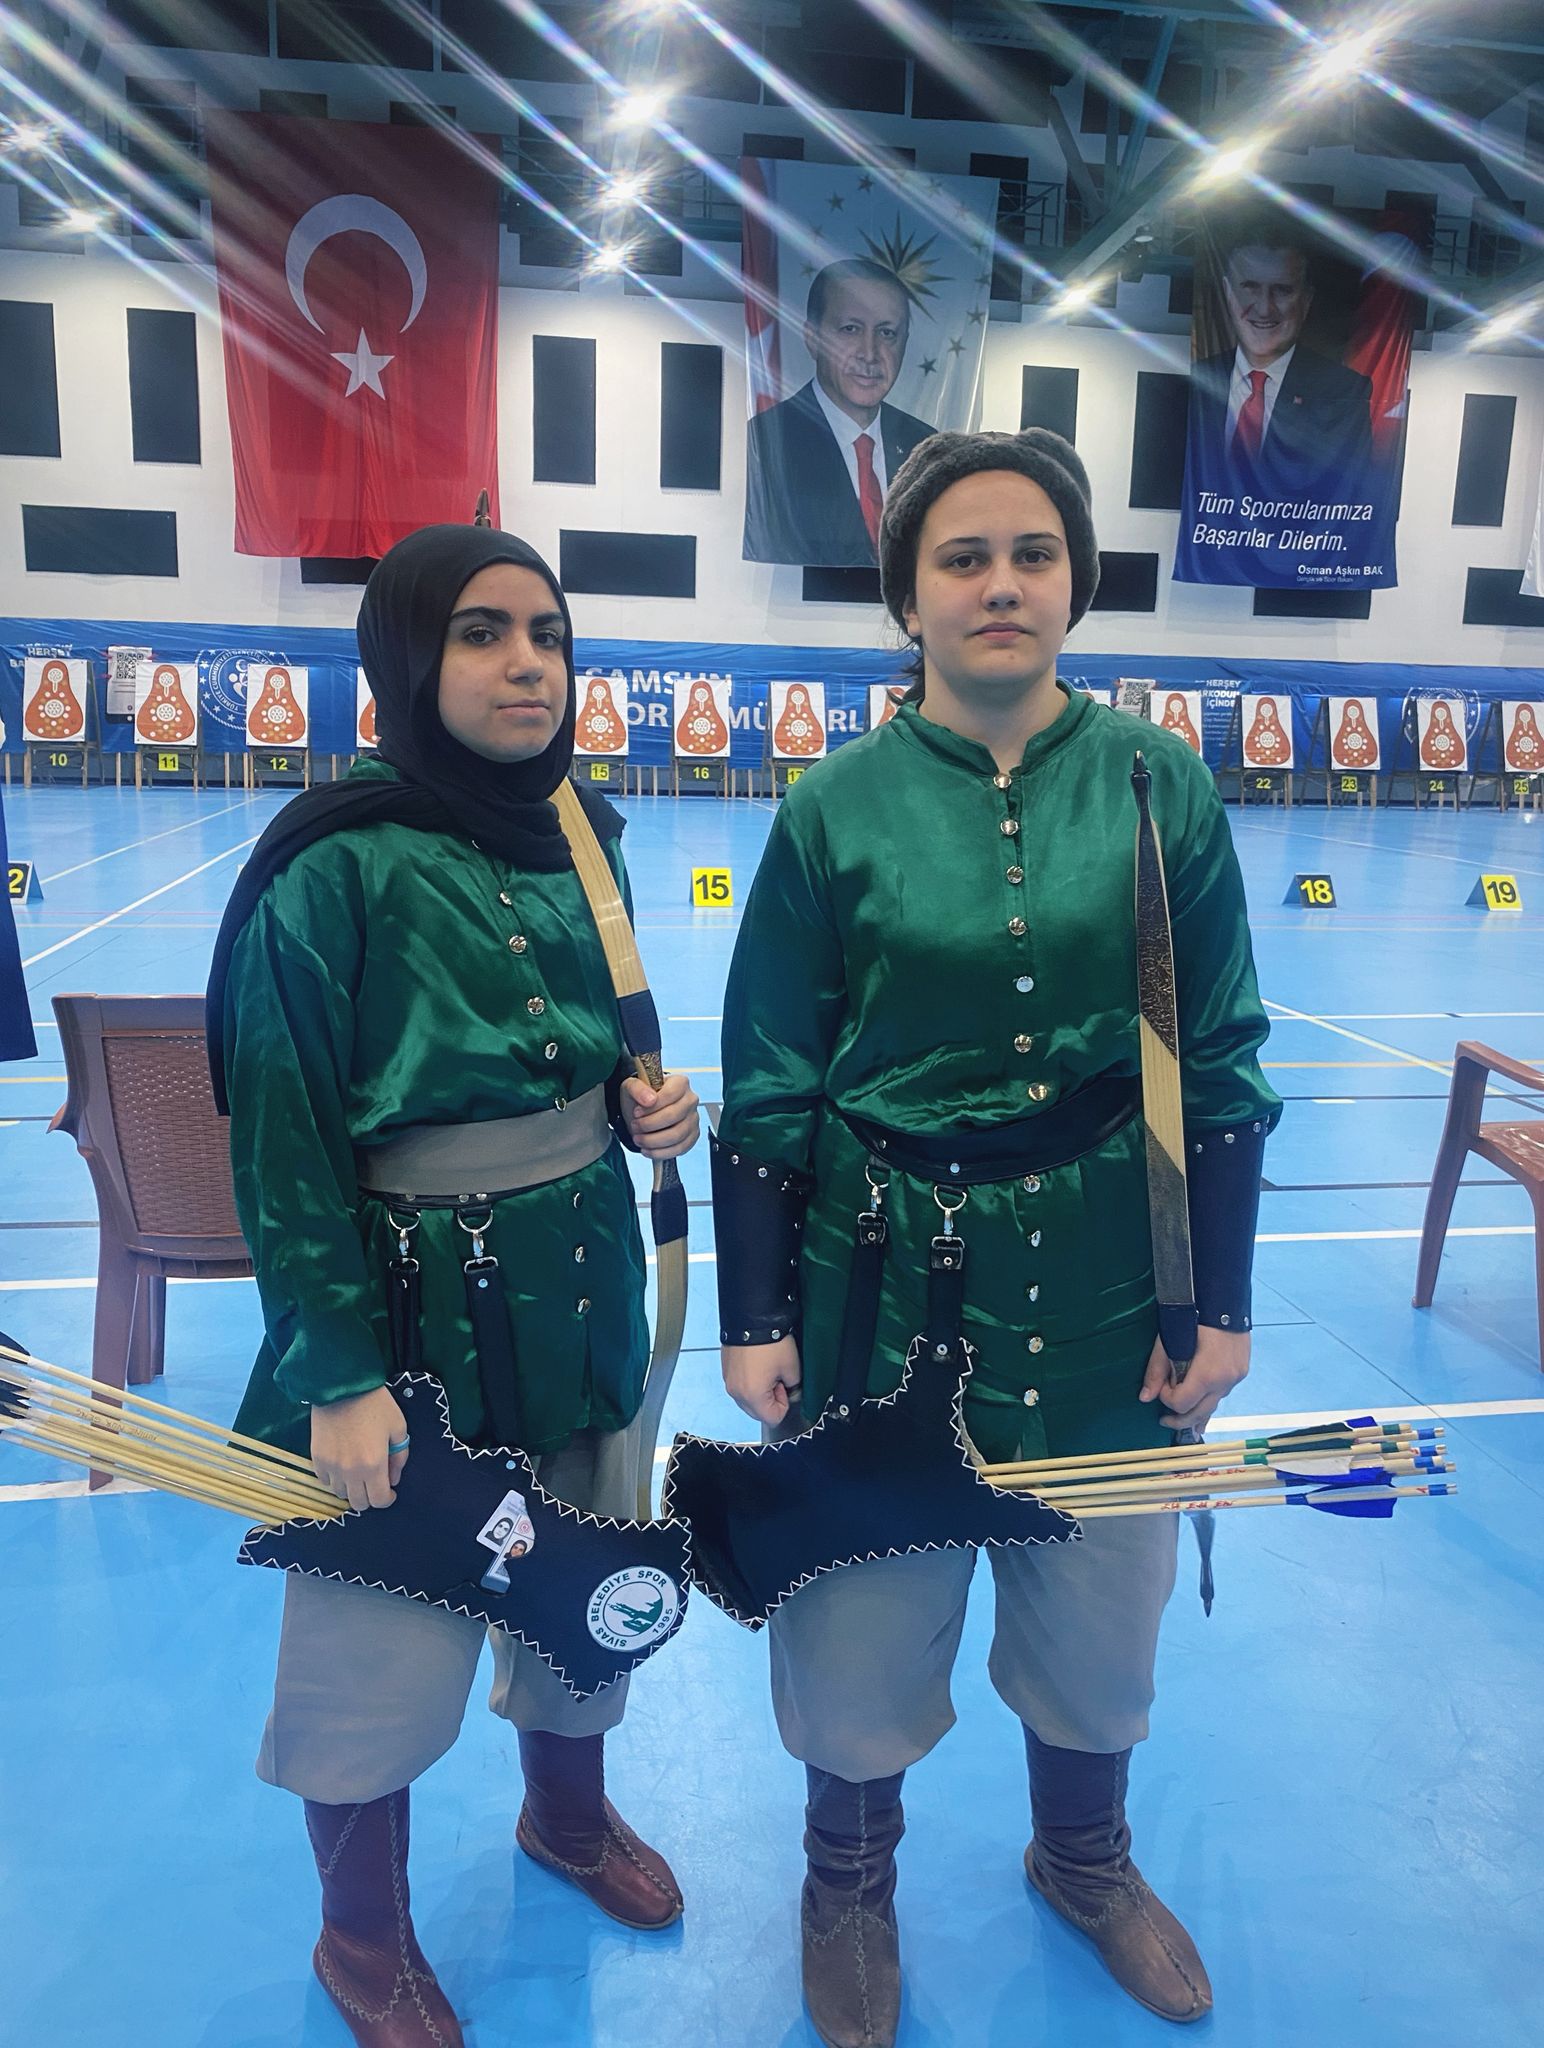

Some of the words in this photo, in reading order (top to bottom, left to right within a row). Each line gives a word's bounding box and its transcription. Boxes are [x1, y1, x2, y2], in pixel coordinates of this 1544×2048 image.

[1198, 492, 1235, 515] Tüm
[1240, 496, 1373, 521] Sporcularımıza
[1192, 523, 1274, 550] Başarılar
[1278, 529, 1348, 551] Dilerim.
[1297, 564, 1332, 575] Osman
[1334, 565, 1360, 577] Aşkın
[1363, 565, 1383, 575] BAK
[1206, 680, 1241, 690] HERŞEY
[50, 754, 68, 766] 10
[160, 757, 176, 768] 11
[270, 758, 288, 770] 12
[591, 766, 608, 778] 15
[693, 767, 710, 779] 16
[1255, 777, 1272, 789] 22
[1342, 778, 1357, 790] 23
[1429, 780, 1444, 792] 24
[1514, 780, 1528, 793] 25
[8, 868, 24, 894] 2
[695, 874, 730, 900] 15
[1300, 879, 1333, 904] 18
[1487, 880, 1517, 904] 19
[637, 1569, 668, 1588] SPOR
[590, 1572, 631, 1623] BELEDİYE
[652, 1607, 674, 1635] 1995
[594, 1626, 627, 1648] SİVAS
